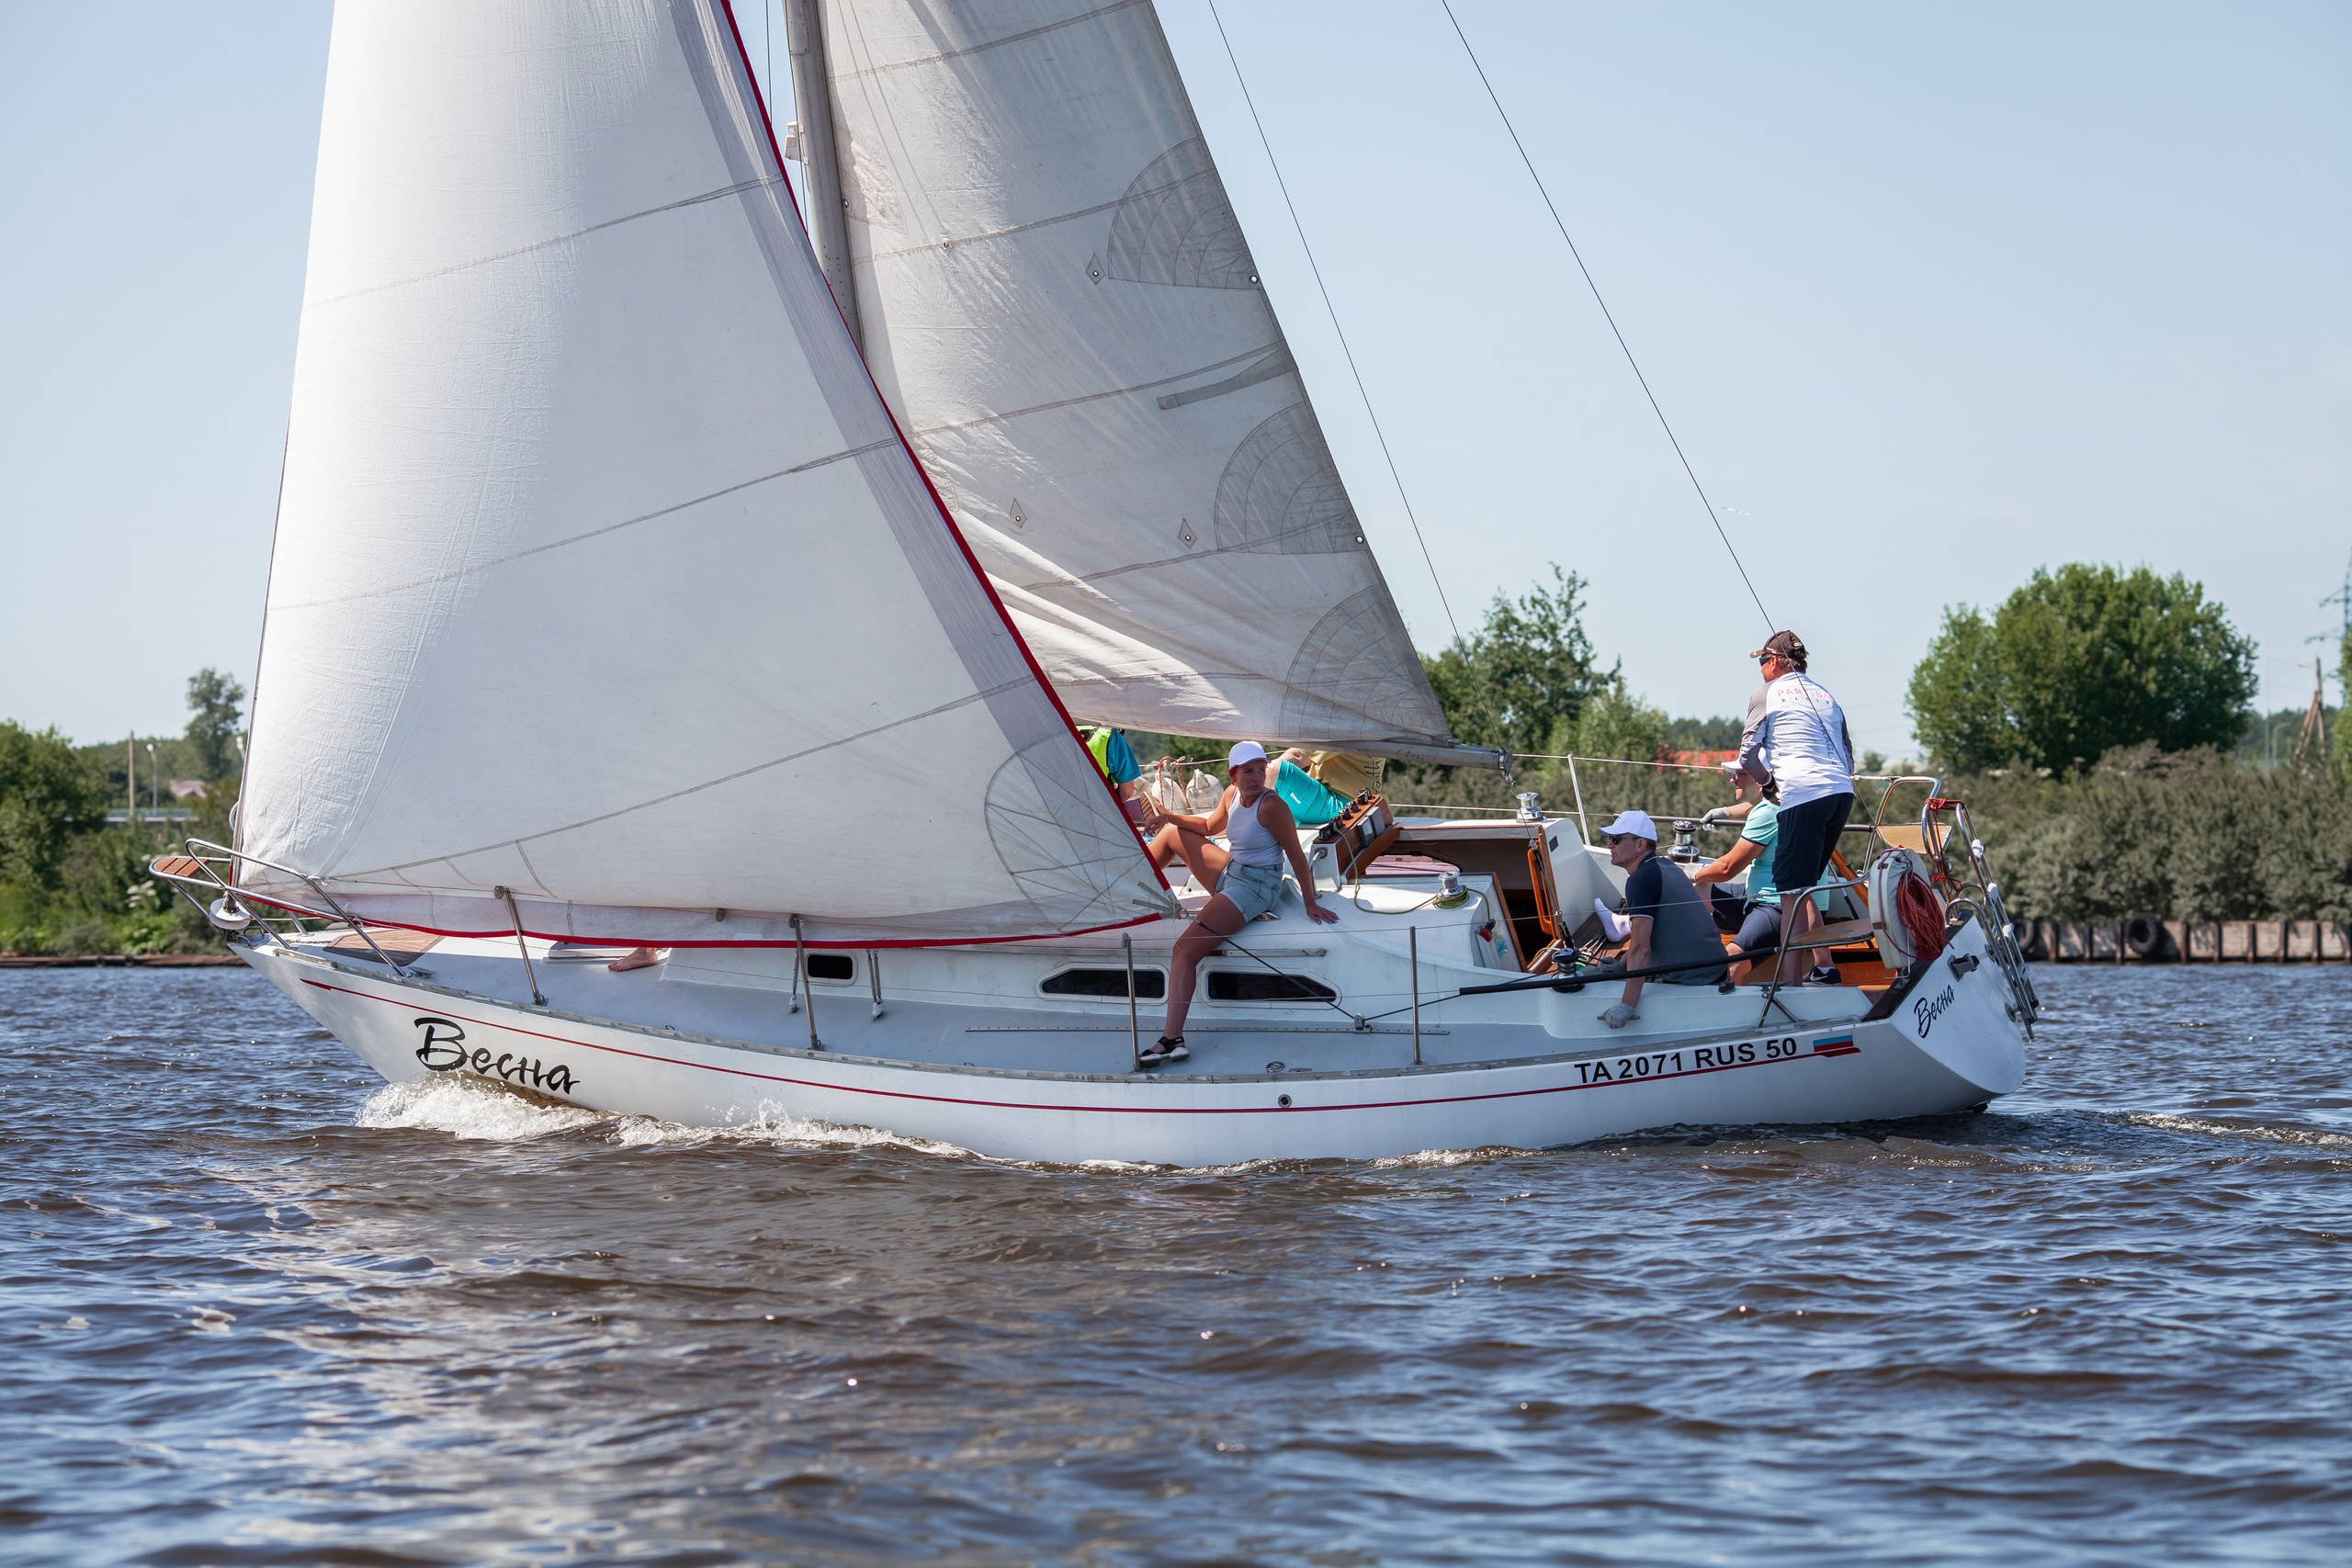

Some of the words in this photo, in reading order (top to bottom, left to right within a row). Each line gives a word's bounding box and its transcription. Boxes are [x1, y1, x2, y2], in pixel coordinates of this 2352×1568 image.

[1913, 984, 1955, 1039] Весна
[413, 1017, 581, 1095] Весна
[1574, 1061, 1613, 1084] TA
[1617, 1052, 1682, 1079] 2071
[1694, 1043, 1756, 1069] RUS
[1766, 1037, 1797, 1058] 50
